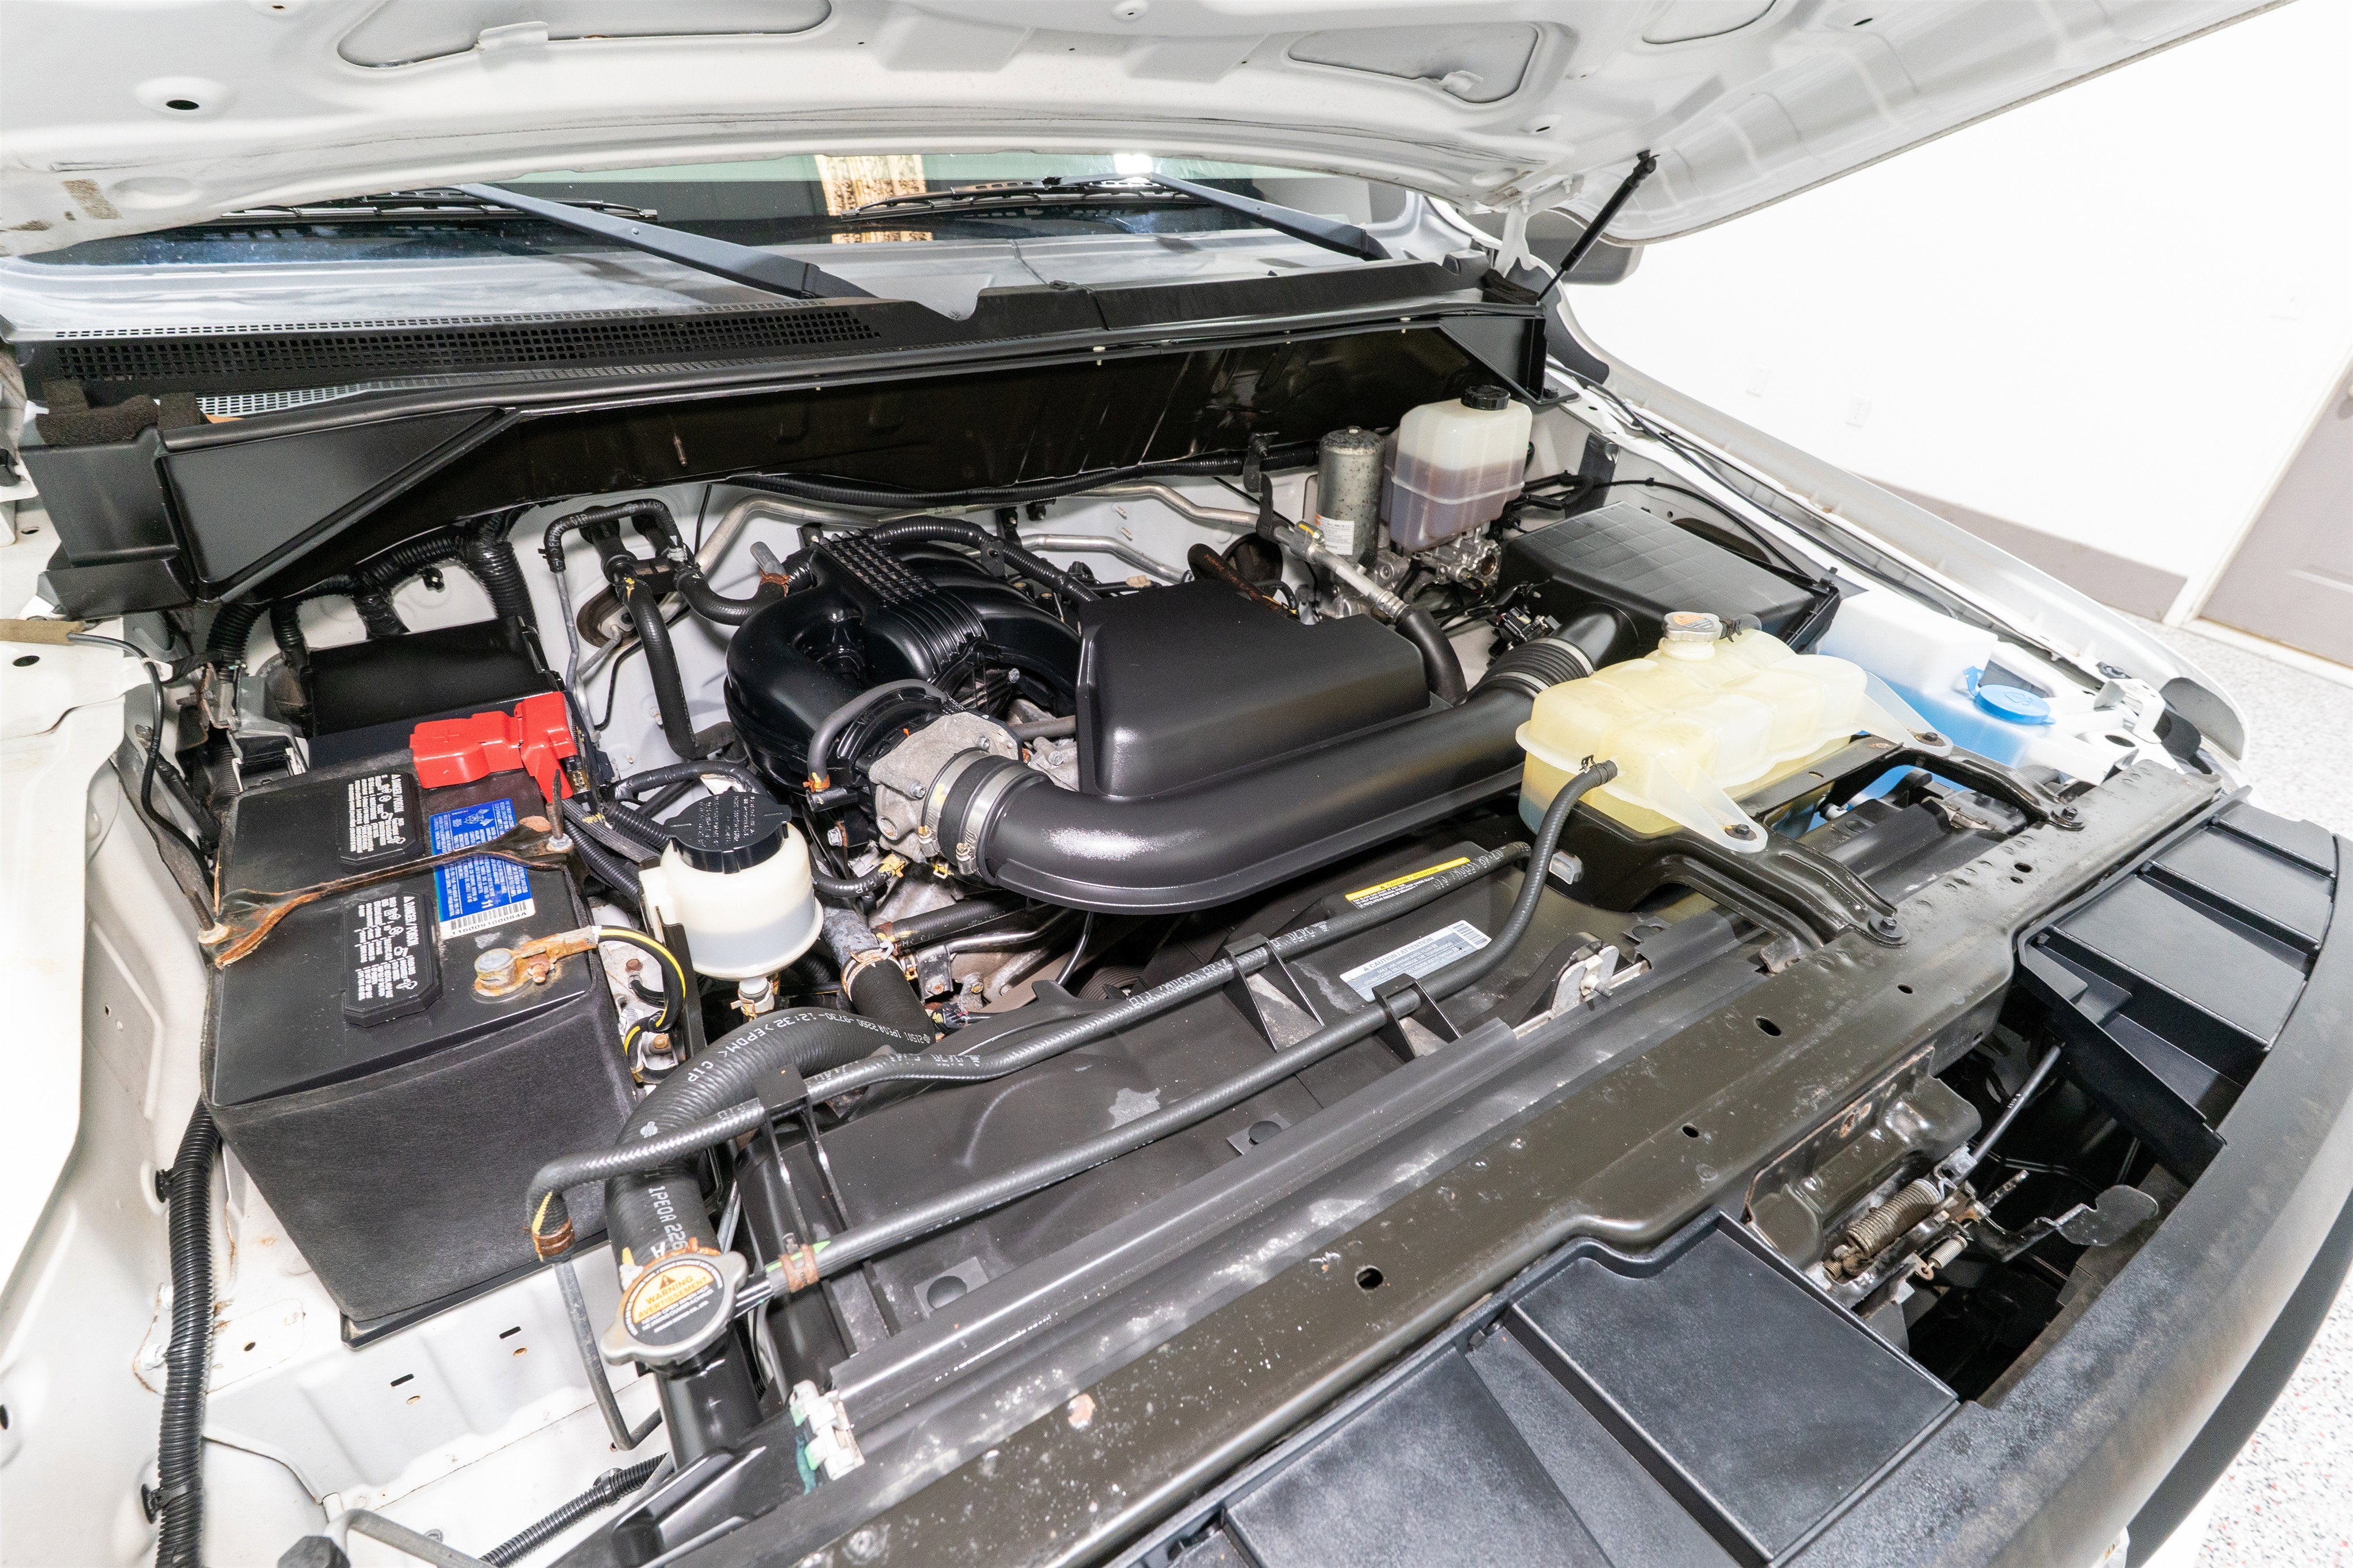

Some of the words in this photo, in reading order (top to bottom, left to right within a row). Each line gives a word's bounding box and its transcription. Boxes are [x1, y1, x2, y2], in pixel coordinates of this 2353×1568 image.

[392, 778, 402, 794] DANGER
[1387, 877, 1408, 886] CAUTION
[403, 901, 416, 923] DANGER
[480, 899, 493, 909] 11
[1369, 953, 1398, 969] CAUTION
[1400, 936, 1434, 955] ATTENTION
[856, 1018, 878, 1031] 2260
[717, 1023, 774, 1057] >EPDM<
[904, 1032, 923, 1044] 21501
[687, 1062, 716, 1085] CIP
[664, 1223, 688, 1251] 226
[637, 1276, 707, 1318] AVERTISSEMENT
[646, 1275, 693, 1304] WARNING
